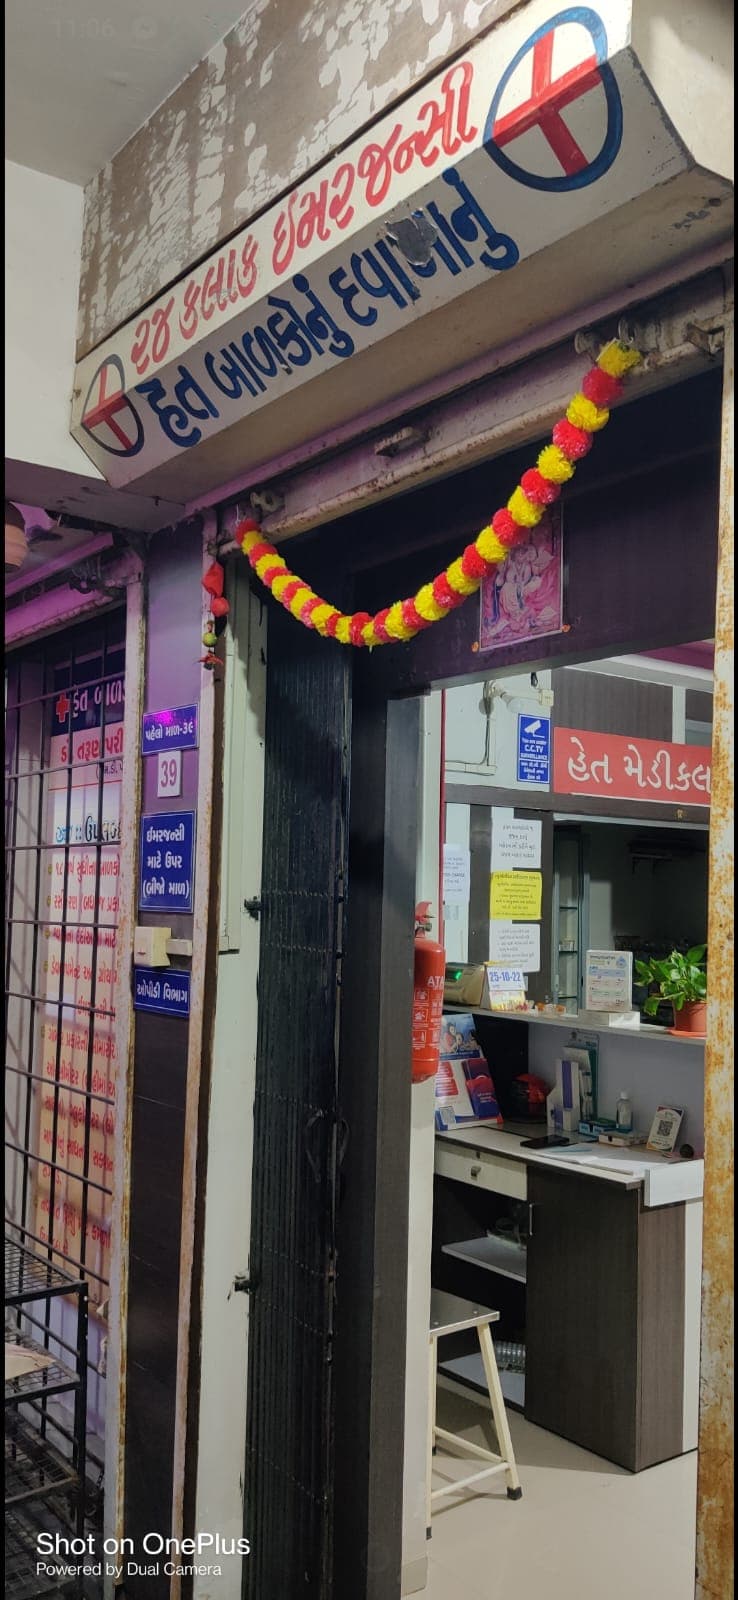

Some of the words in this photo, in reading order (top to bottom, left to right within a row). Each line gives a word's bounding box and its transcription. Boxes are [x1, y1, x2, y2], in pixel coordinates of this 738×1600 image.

[179, 236, 258, 340] કલાક
[204, 273, 355, 399] બાળકોનું
[145, 723, 163, 741] પહેલો
[568, 736, 613, 784] હેત
[160, 759, 177, 788] 39
[146, 823, 185, 842] ઈમરજન્સી
[147, 850, 161, 869] માટે
[165, 851, 182, 868] ઉપર
[142, 876, 165, 898] (બીજો
[168, 879, 190, 899] માળ)
[489, 971, 520, 982] 25-10-22
[136, 978, 160, 999] ઓપીડી
[163, 982, 188, 1003] વિભાગ
